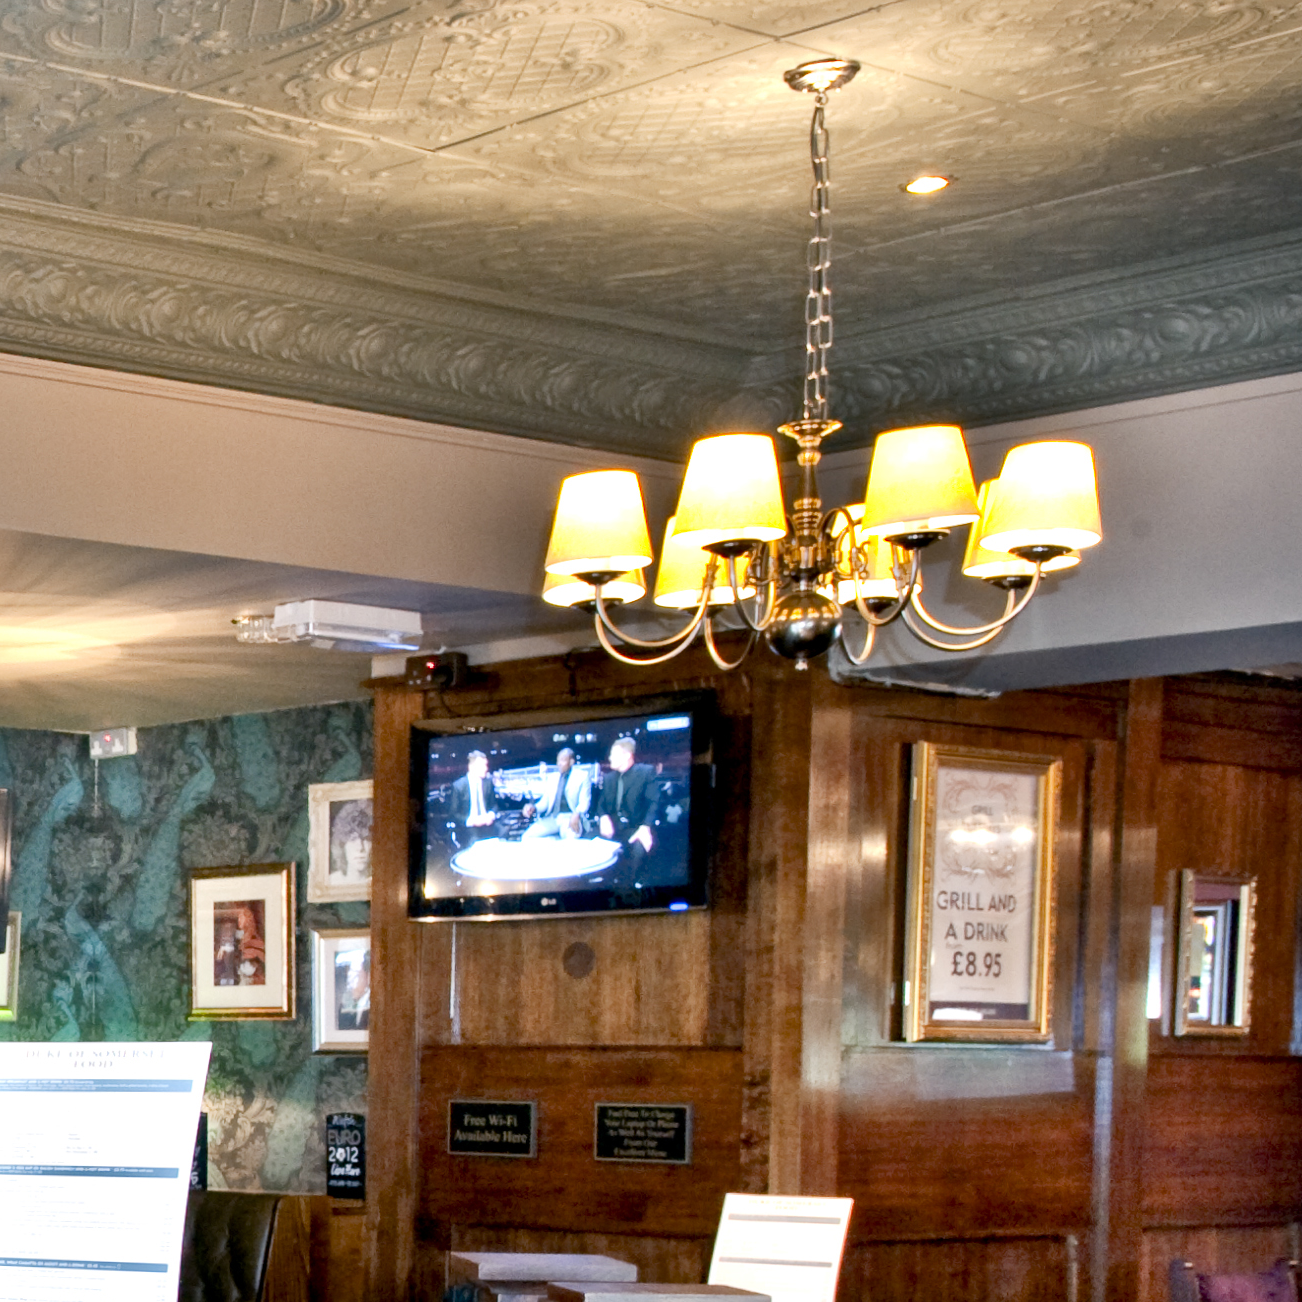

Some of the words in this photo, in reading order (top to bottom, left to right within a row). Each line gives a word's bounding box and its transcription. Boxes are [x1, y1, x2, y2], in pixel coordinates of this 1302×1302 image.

[936, 890, 984, 911] GRILL
[988, 894, 1017, 913] AND
[944, 922, 958, 940] A
[964, 922, 1009, 942] DRINK
[951, 951, 1002, 978] £8.95
[463, 1113, 486, 1127] Free
[488, 1114, 517, 1127] Wi-Fi
[327, 1129, 361, 1145] EURO
[454, 1129, 501, 1142] Available
[502, 1130, 528, 1144] Here
[328, 1146, 359, 1162] 2012
